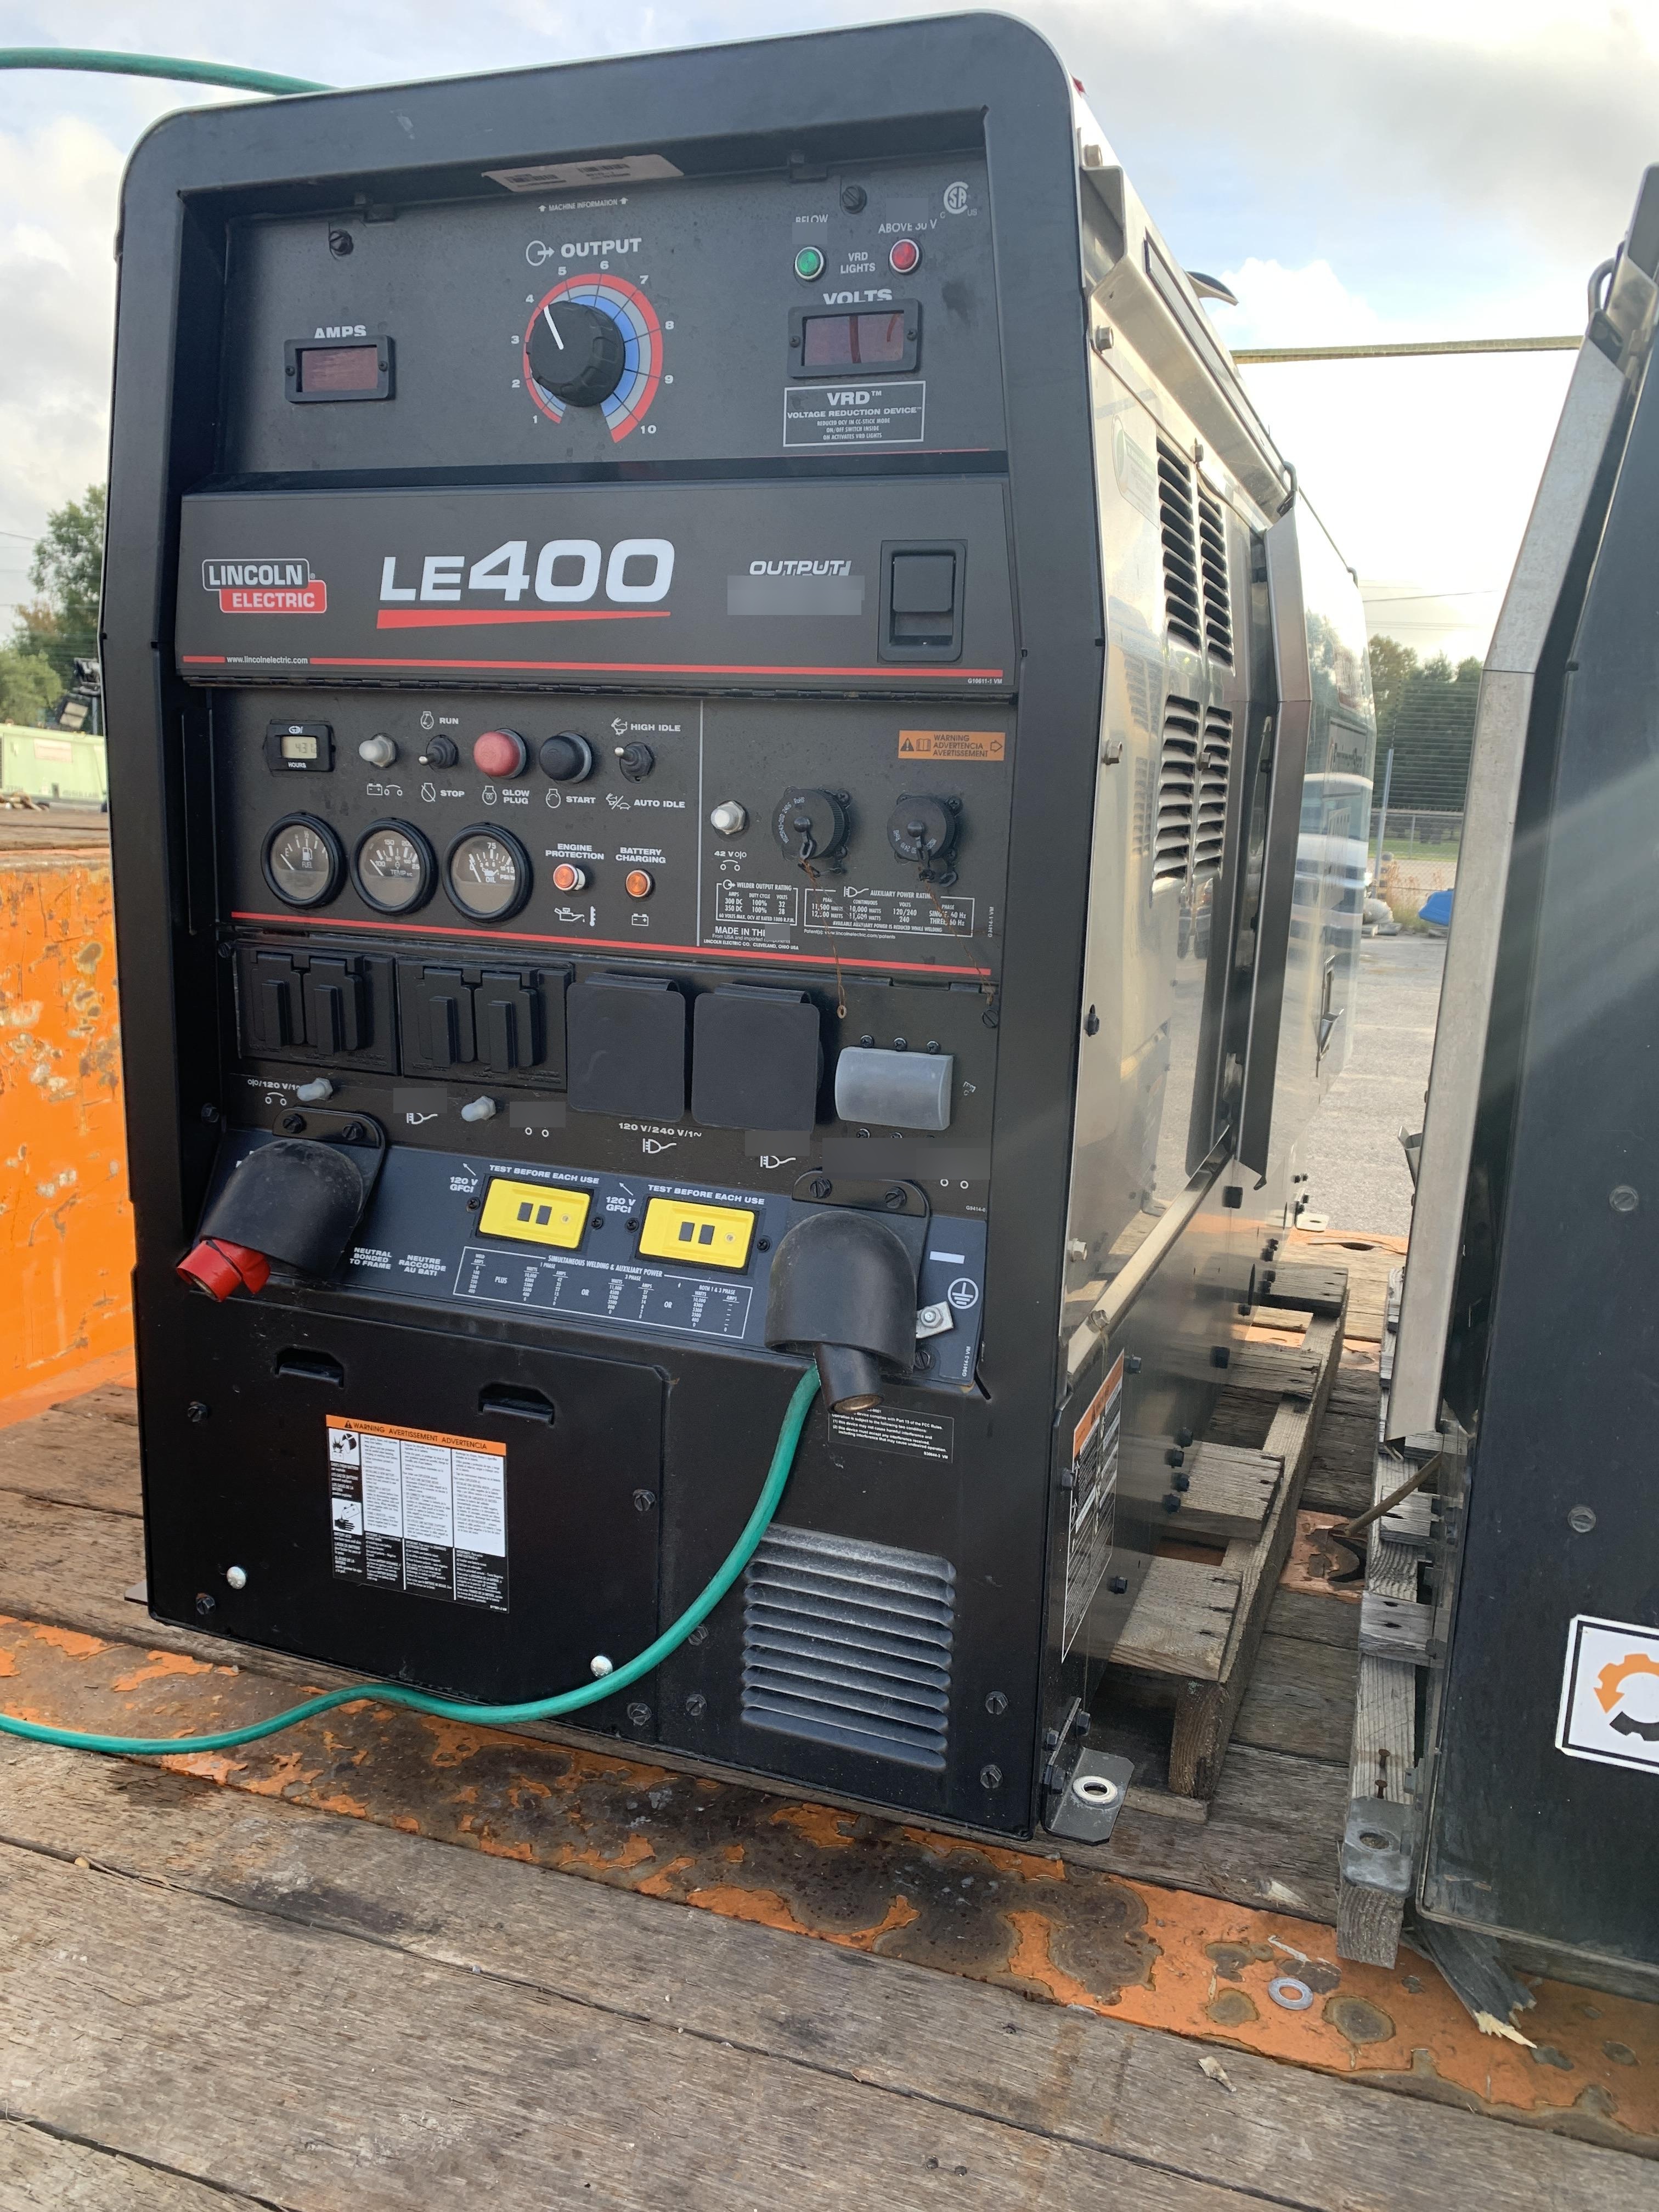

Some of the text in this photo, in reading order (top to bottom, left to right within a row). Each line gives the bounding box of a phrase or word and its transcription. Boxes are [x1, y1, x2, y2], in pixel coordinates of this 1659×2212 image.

[549, 199, 618, 211] MACHINE INFORMATION
[878, 223, 912, 234] ABOVE
[930, 219, 937, 229] V
[561, 238, 642, 258] OUTPUT
[848, 252, 868, 262] VRD
[600, 261, 608, 269] 6
[840, 263, 876, 274] LIGHTS
[558, 267, 566, 275] 5
[640, 275, 648, 284] 7
[526, 295, 534, 303] 4
[823, 289, 892, 304] VOLTS
[665, 321, 674, 330] 8
[314, 325, 366, 338] AMPS
[511, 335, 520, 344] 3
[512, 380, 520, 388] 2
[665, 375, 673, 383] 9
[533, 415, 537, 424] 1
[641, 425, 657, 434] 10
[380, 539, 674, 602] LE400
[749, 560, 844, 575] OUTPUT
[209, 565, 302, 585] LINCOLN
[233, 592, 314, 607] ELECTRIC
[227, 656, 308, 664] www.lincolnelectric.com
[557, 843, 592, 851] ENGINE
[620, 847, 662, 855] BATTERY
[545, 850, 604, 860] PROTECTION
[616, 854, 666, 864] CHARGING
[715, 926, 739, 935] MADE
[640, 1125, 674, 1135] V/240
[489, 1165, 512, 1173] TEST
[514, 1168, 551, 1178] BEFORE
[552, 1173, 578, 1181] EACH
[450, 1176, 469, 1184] 120
[450, 1184, 474, 1193] GFCI
[648, 1184, 765, 1205] TEST BEFORE EACH USE
[606, 1204, 631, 1213] GFCI
[353, 1252, 389, 1263] BONDED
[354, 1247, 392, 1258] NEUTRAL
[362, 1260, 392, 1270] FRAME
[407, 1255, 441, 1265] NEUTRE
[398, 1259, 447, 1272] RACCORDE
[548, 1255, 585, 1267] SIMULTANEOUS
[586, 1261, 609, 1269] WELDING
[615, 1265, 643, 1274] AUXILIARY
[644, 1269, 663, 1277] POWER
[417, 1268, 438, 1277] BATI
[966, 1346, 971, 1354] VM
[354, 1422, 487, 1450] WARNING AVERTISSEMENT ADVERTENCIA
